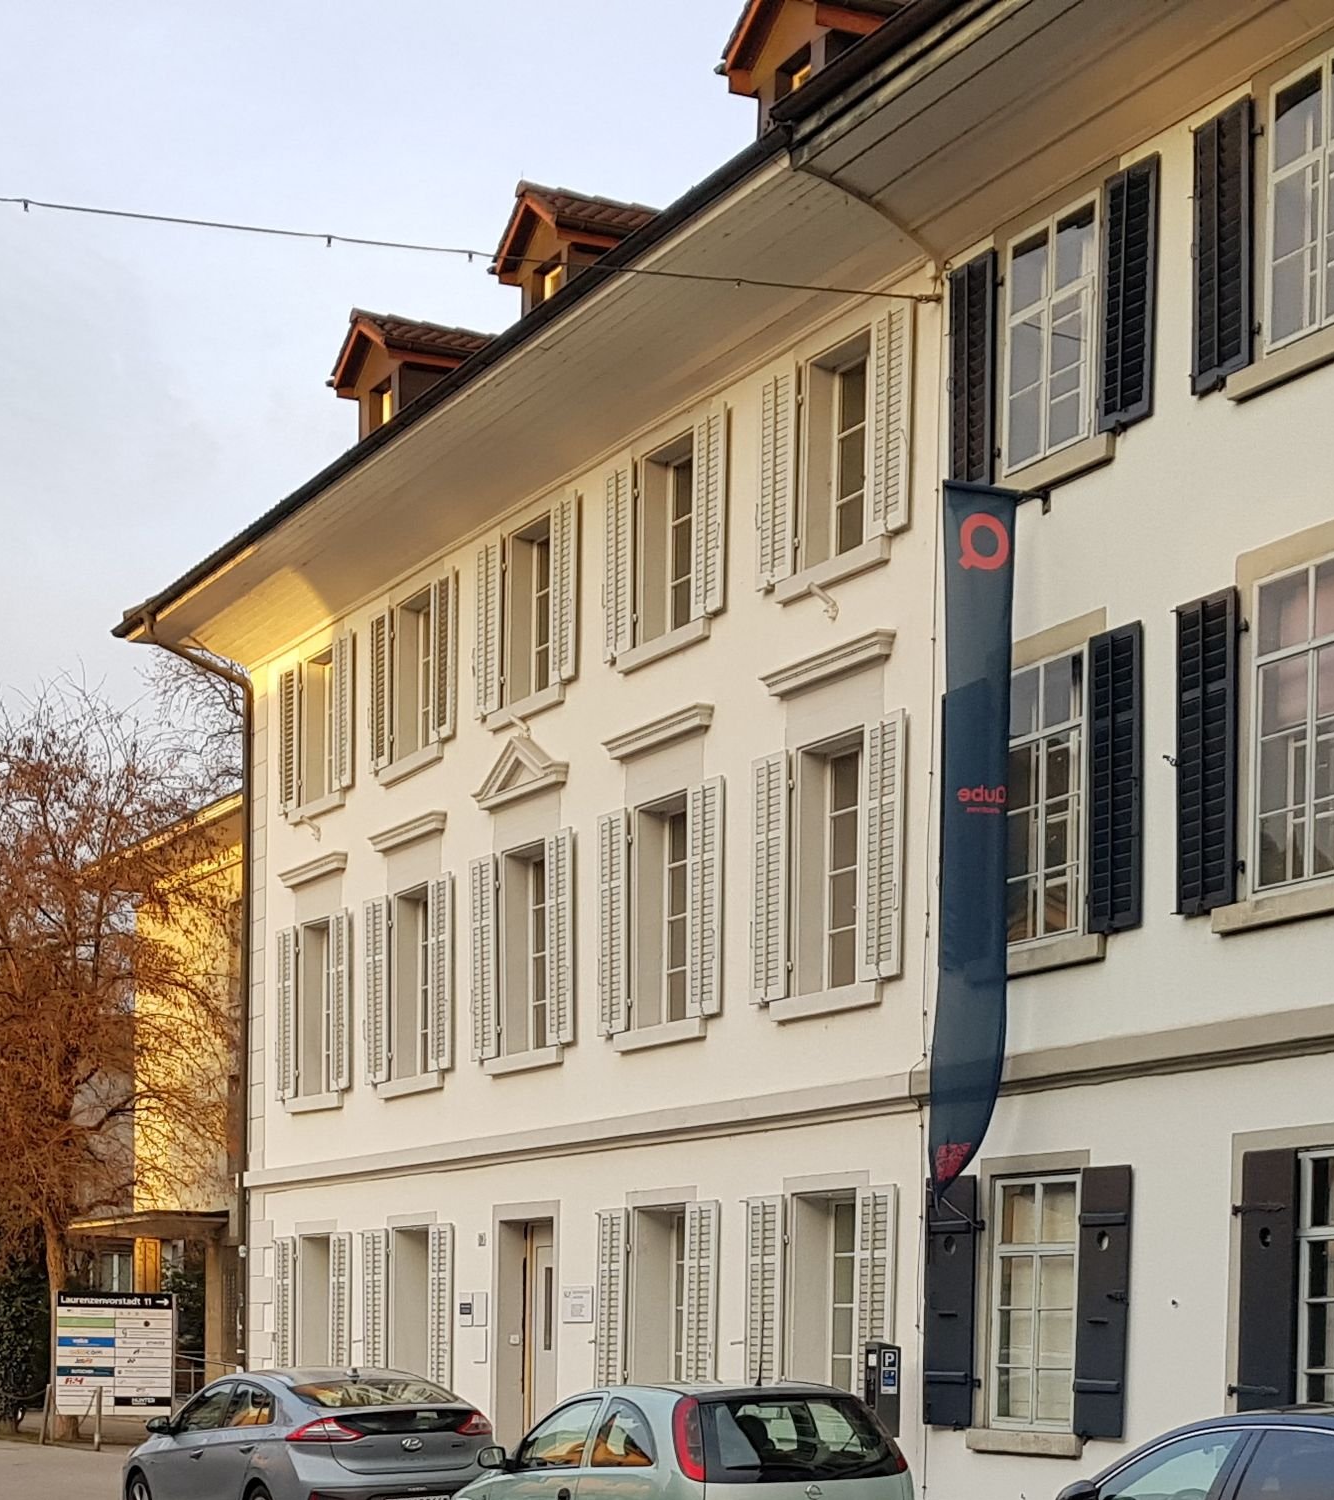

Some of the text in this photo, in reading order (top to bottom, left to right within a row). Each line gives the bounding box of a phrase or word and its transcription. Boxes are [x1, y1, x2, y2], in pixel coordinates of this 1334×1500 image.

[60, 1295, 152, 1306] Laurenzenvorstadt 11
[884, 1352, 895, 1367] P
